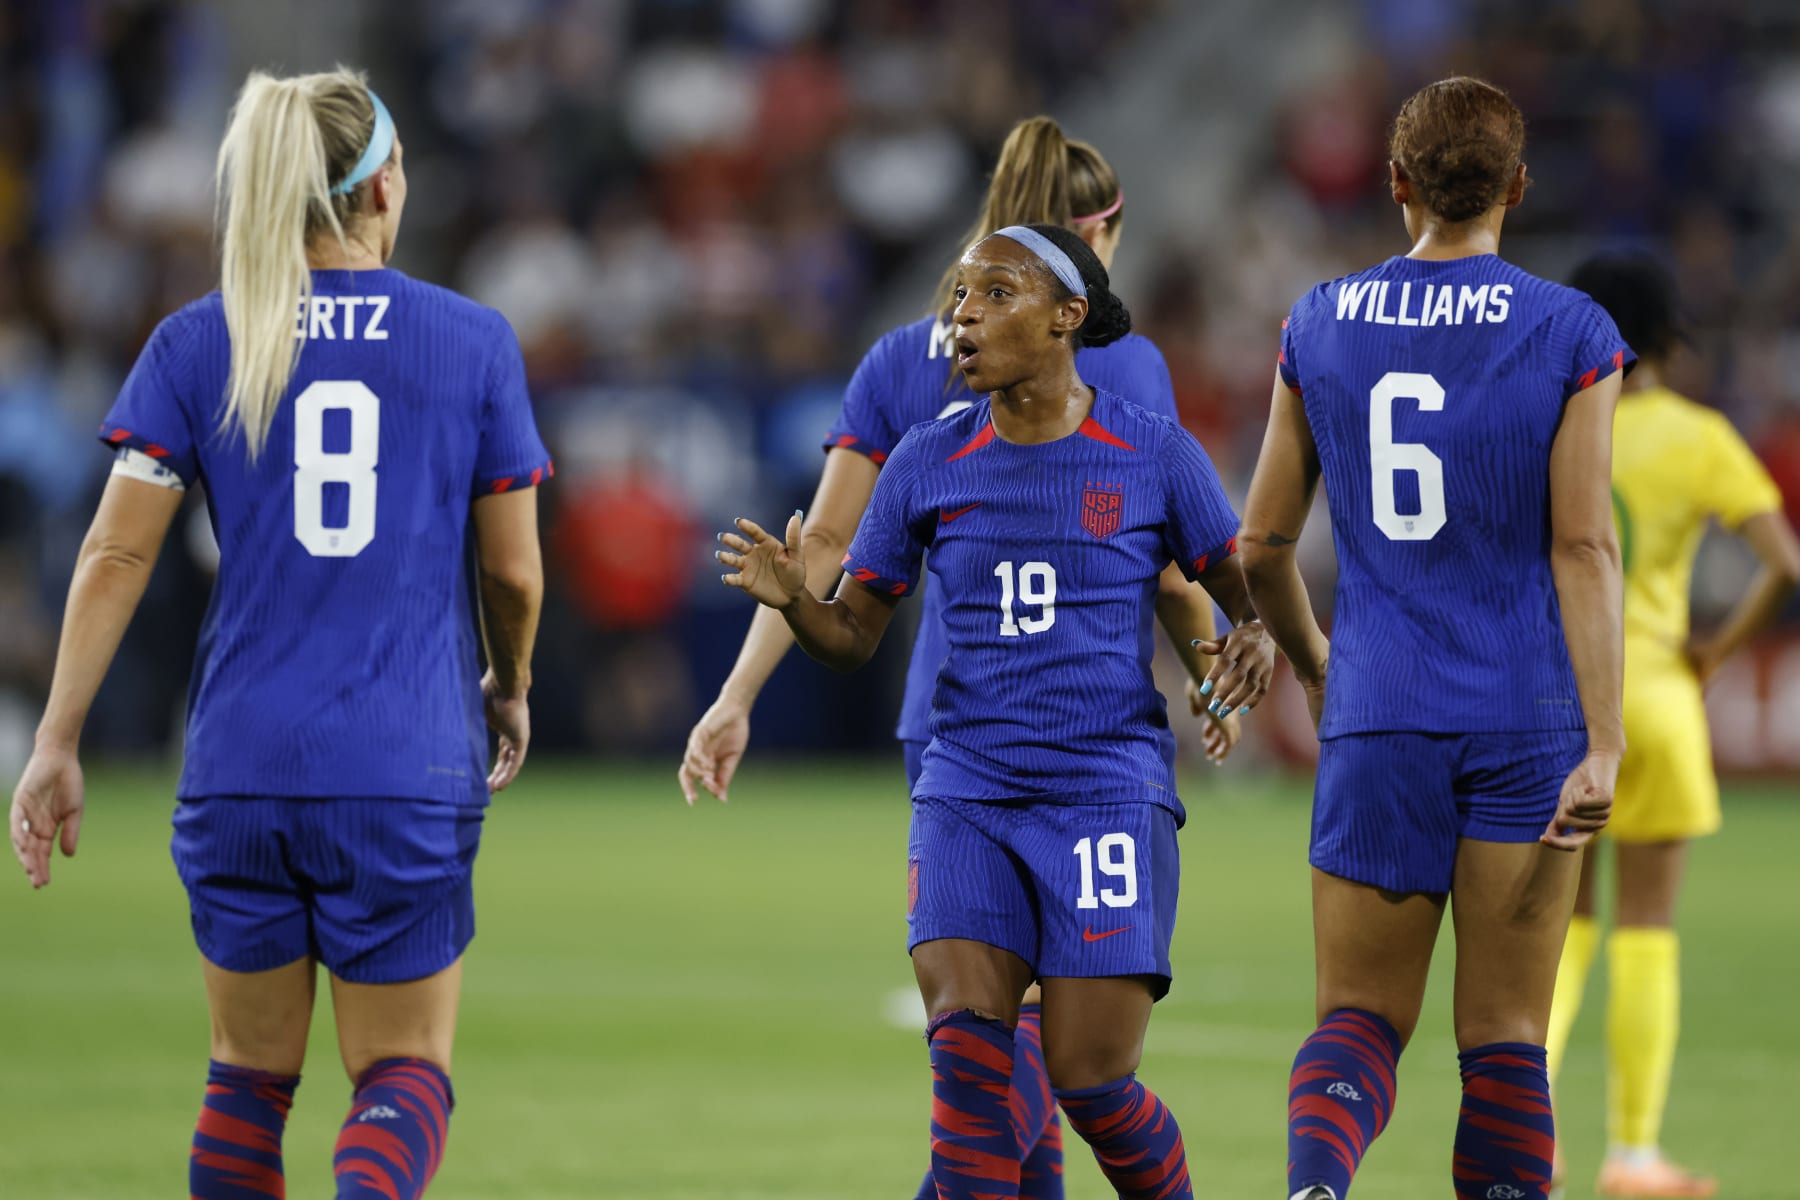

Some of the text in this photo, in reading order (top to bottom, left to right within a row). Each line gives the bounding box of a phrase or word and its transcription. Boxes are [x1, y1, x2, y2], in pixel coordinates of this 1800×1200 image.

[293, 295, 390, 340] ERTZ
[1336, 281, 1514, 327] WILLIAMS
[294, 380, 380, 557] 8
[1369, 372, 1447, 541] 6
[1085, 493, 1120, 513] USA
[994, 561, 1057, 636] 19
[1073, 832, 1138, 909] 19
